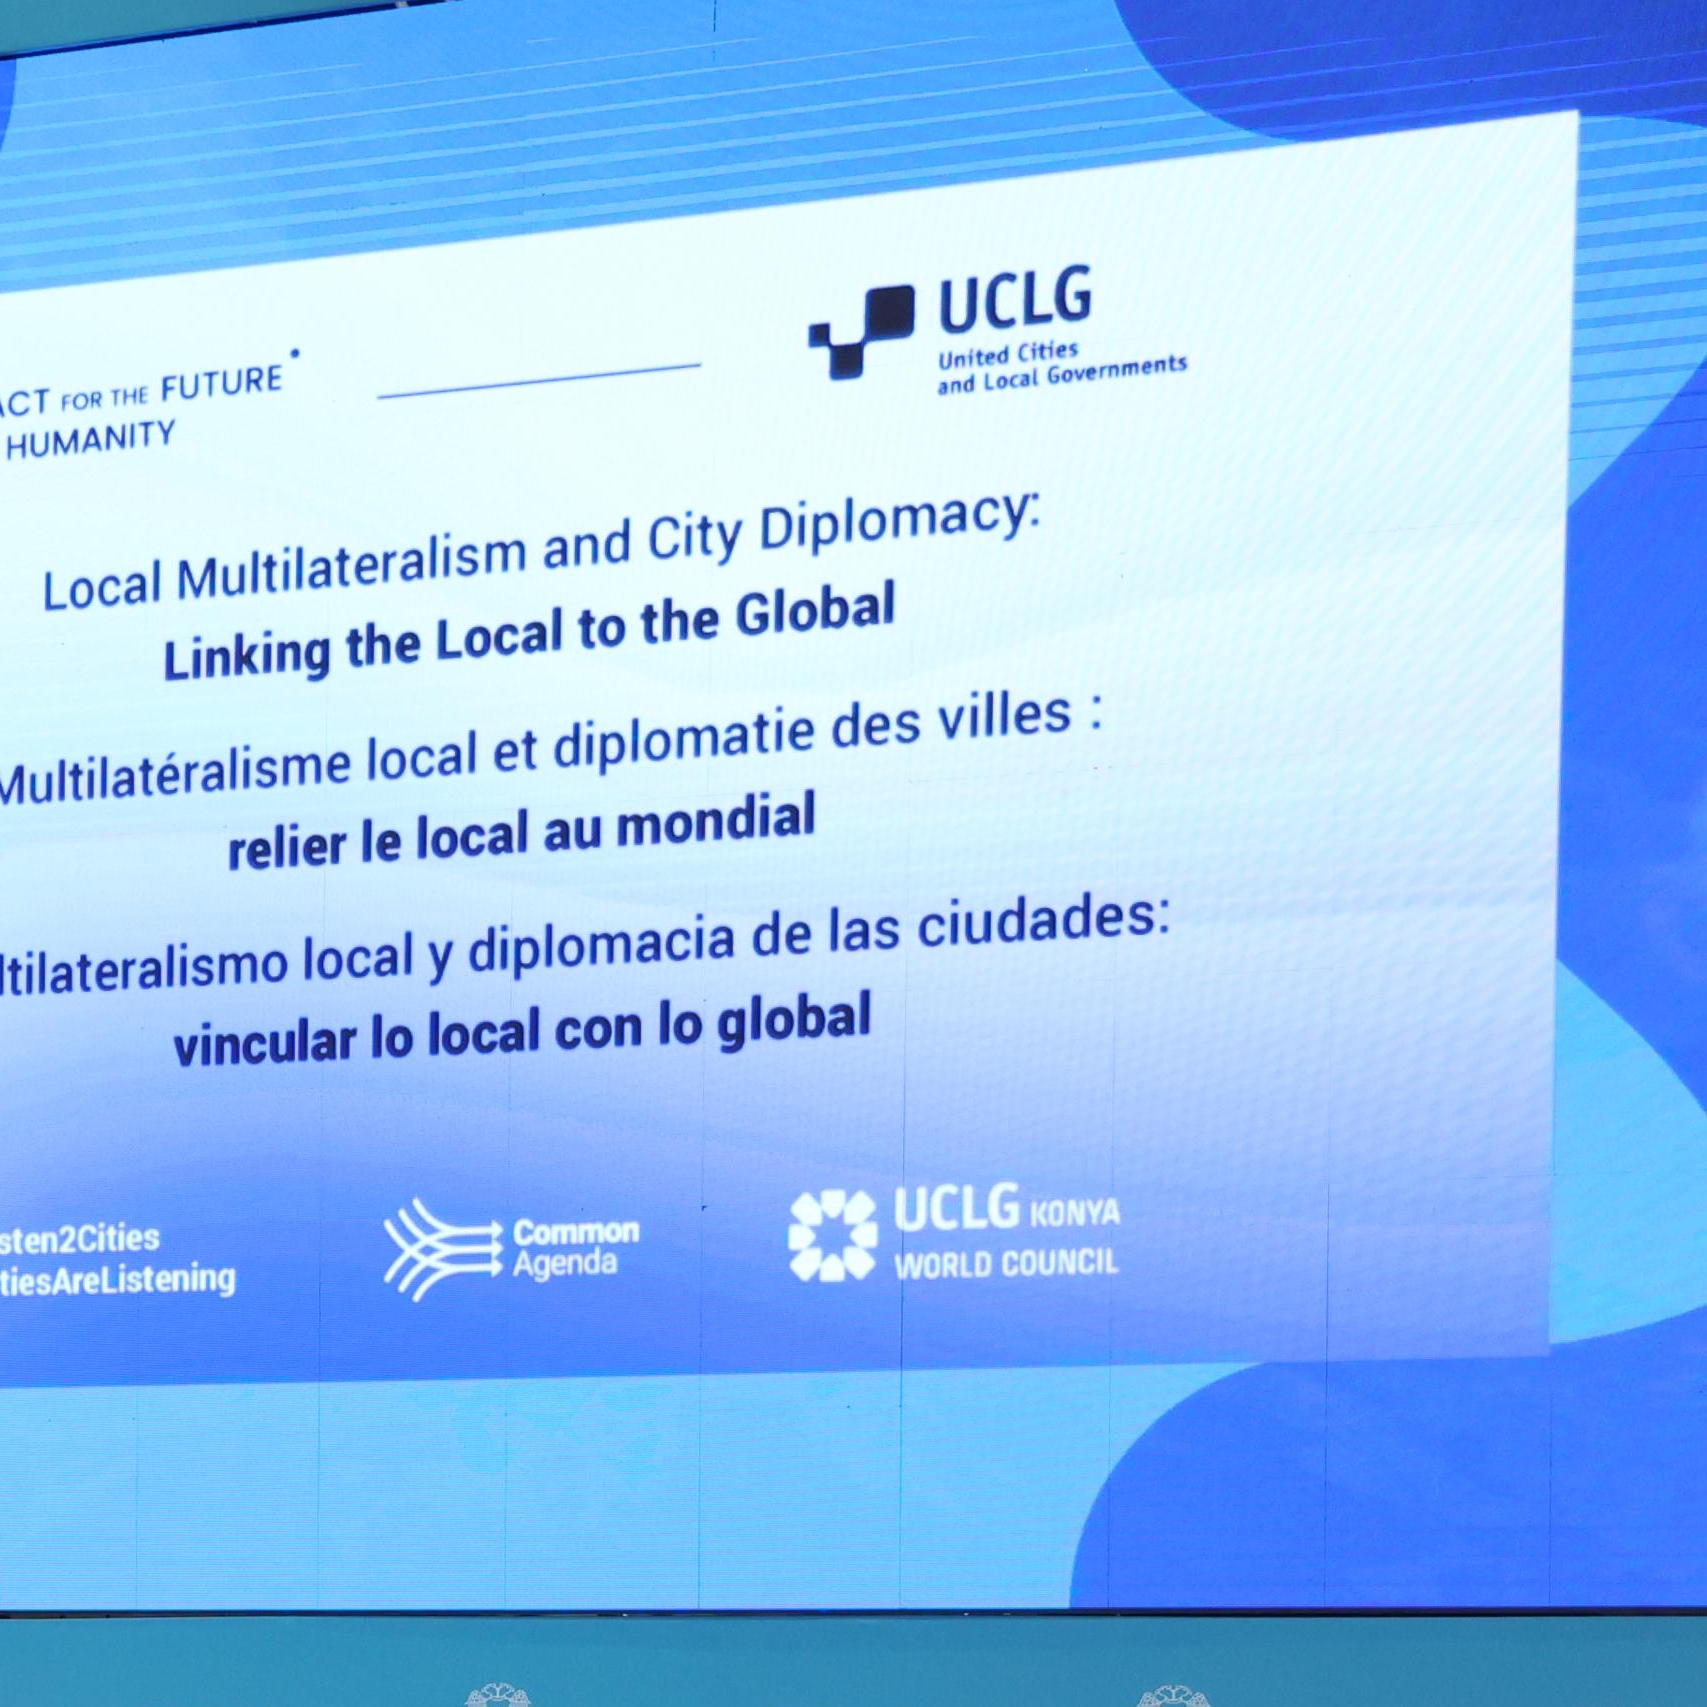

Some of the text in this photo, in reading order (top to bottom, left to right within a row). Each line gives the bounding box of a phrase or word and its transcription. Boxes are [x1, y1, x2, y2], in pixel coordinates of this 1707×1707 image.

[941, 264, 1091, 334] UCLG
[938, 355, 1188, 395] and Local Governments
[939, 340, 1079, 370] United Cities
[62, 391, 102, 411] FOR
[111, 386, 147, 406] THE
[162, 365, 281, 401] FUTURE
[7, 419, 175, 460] HUMANITY
[45, 493, 1039, 611] Local Multilateralism and City Diplomacy:
[165, 579, 894, 682] Linking the Local to the Global
[368, 730, 475, 780] local
[494, 731, 537, 772] et
[554, 706, 814, 776] diplomatie
[833, 701, 920, 748] des
[939, 690, 1070, 739] villes
[230, 789, 814, 870] relier le local au mondial
[305, 931, 412, 980] local
[428, 941, 453, 986] y
[469, 913, 734, 981] diplomacia
[753, 910, 811, 956] de
[830, 907, 899, 952] las
[919, 891, 1168, 947] ciudades:
[174, 989, 870, 1067] vincular lo local con lo global
[514, 1218, 640, 1246] Common
[895, 1182, 1120, 1232] UCLG KONYA
[513, 1246, 618, 1283] Agenda
[895, 1247, 1119, 1279] WORLD COUNCIL
